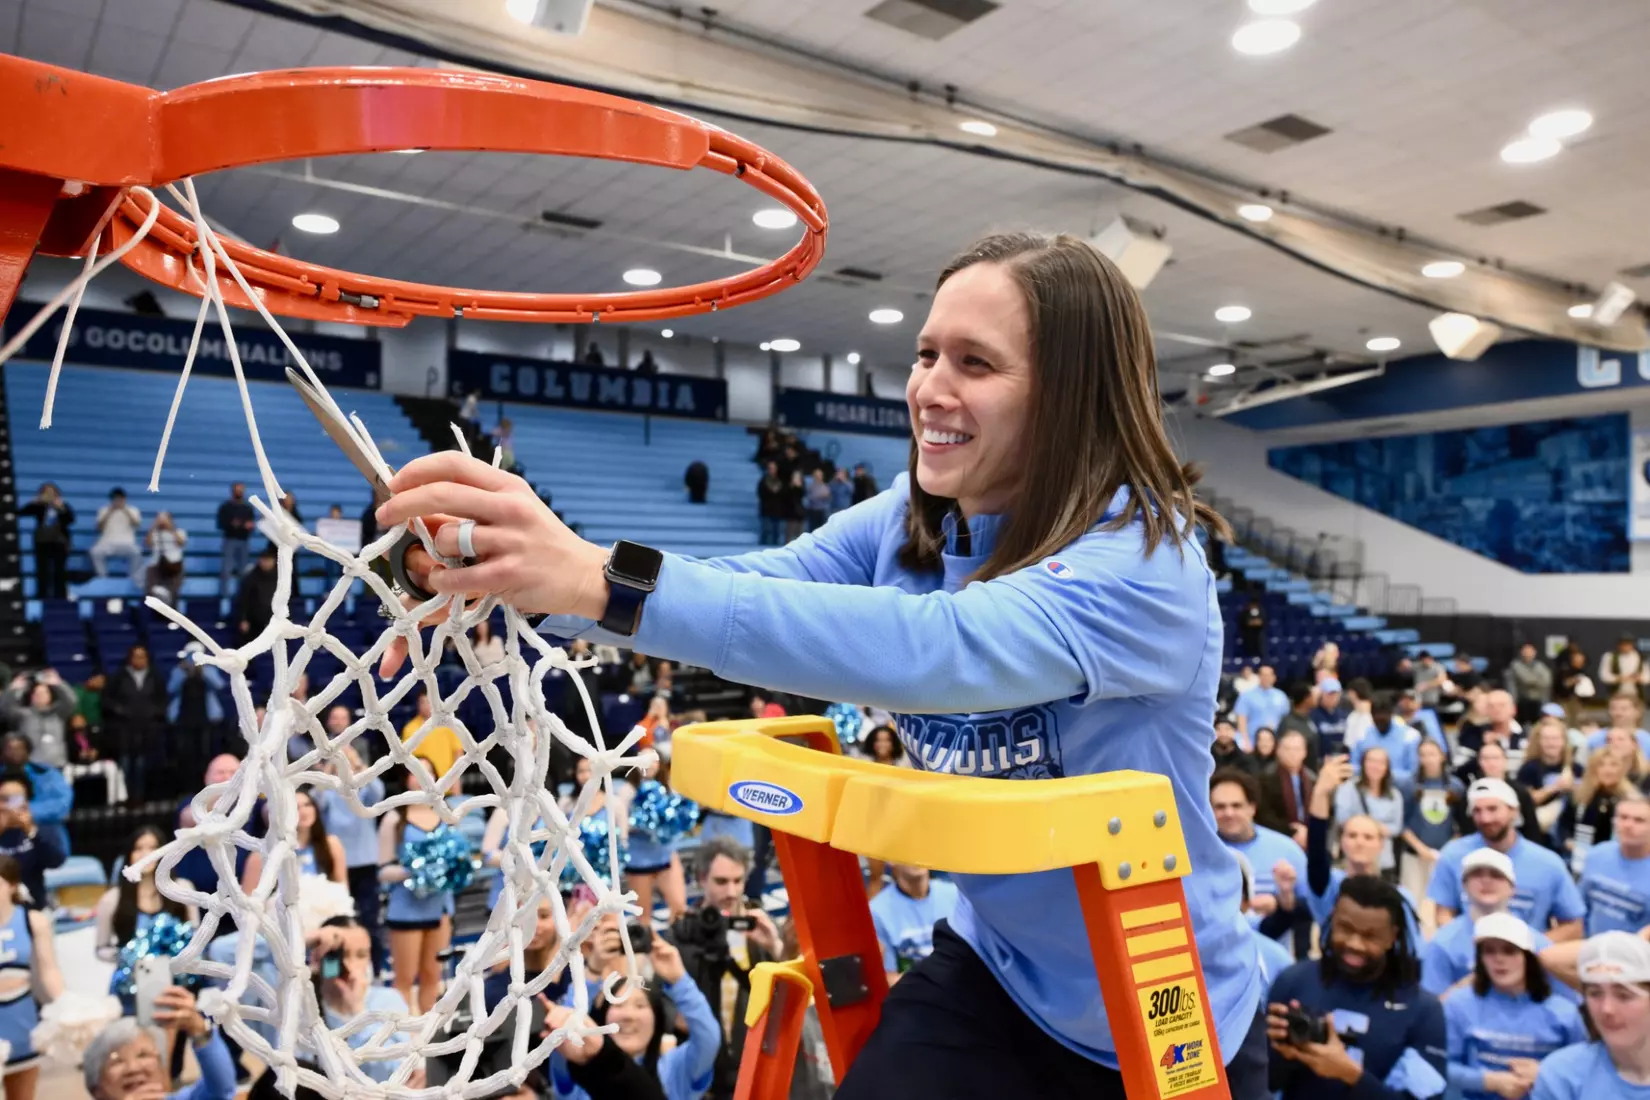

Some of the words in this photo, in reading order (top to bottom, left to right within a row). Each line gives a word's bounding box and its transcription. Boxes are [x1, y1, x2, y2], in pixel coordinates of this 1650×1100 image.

[84, 325, 344, 372] GOCOLUMIALIONS
[490, 363, 696, 411] COLUMBIA
[742, 787, 788, 808] WERNER
[1155, 1017, 1168, 1027] LOAD
[1169, 1011, 1192, 1024] CAPACITY
